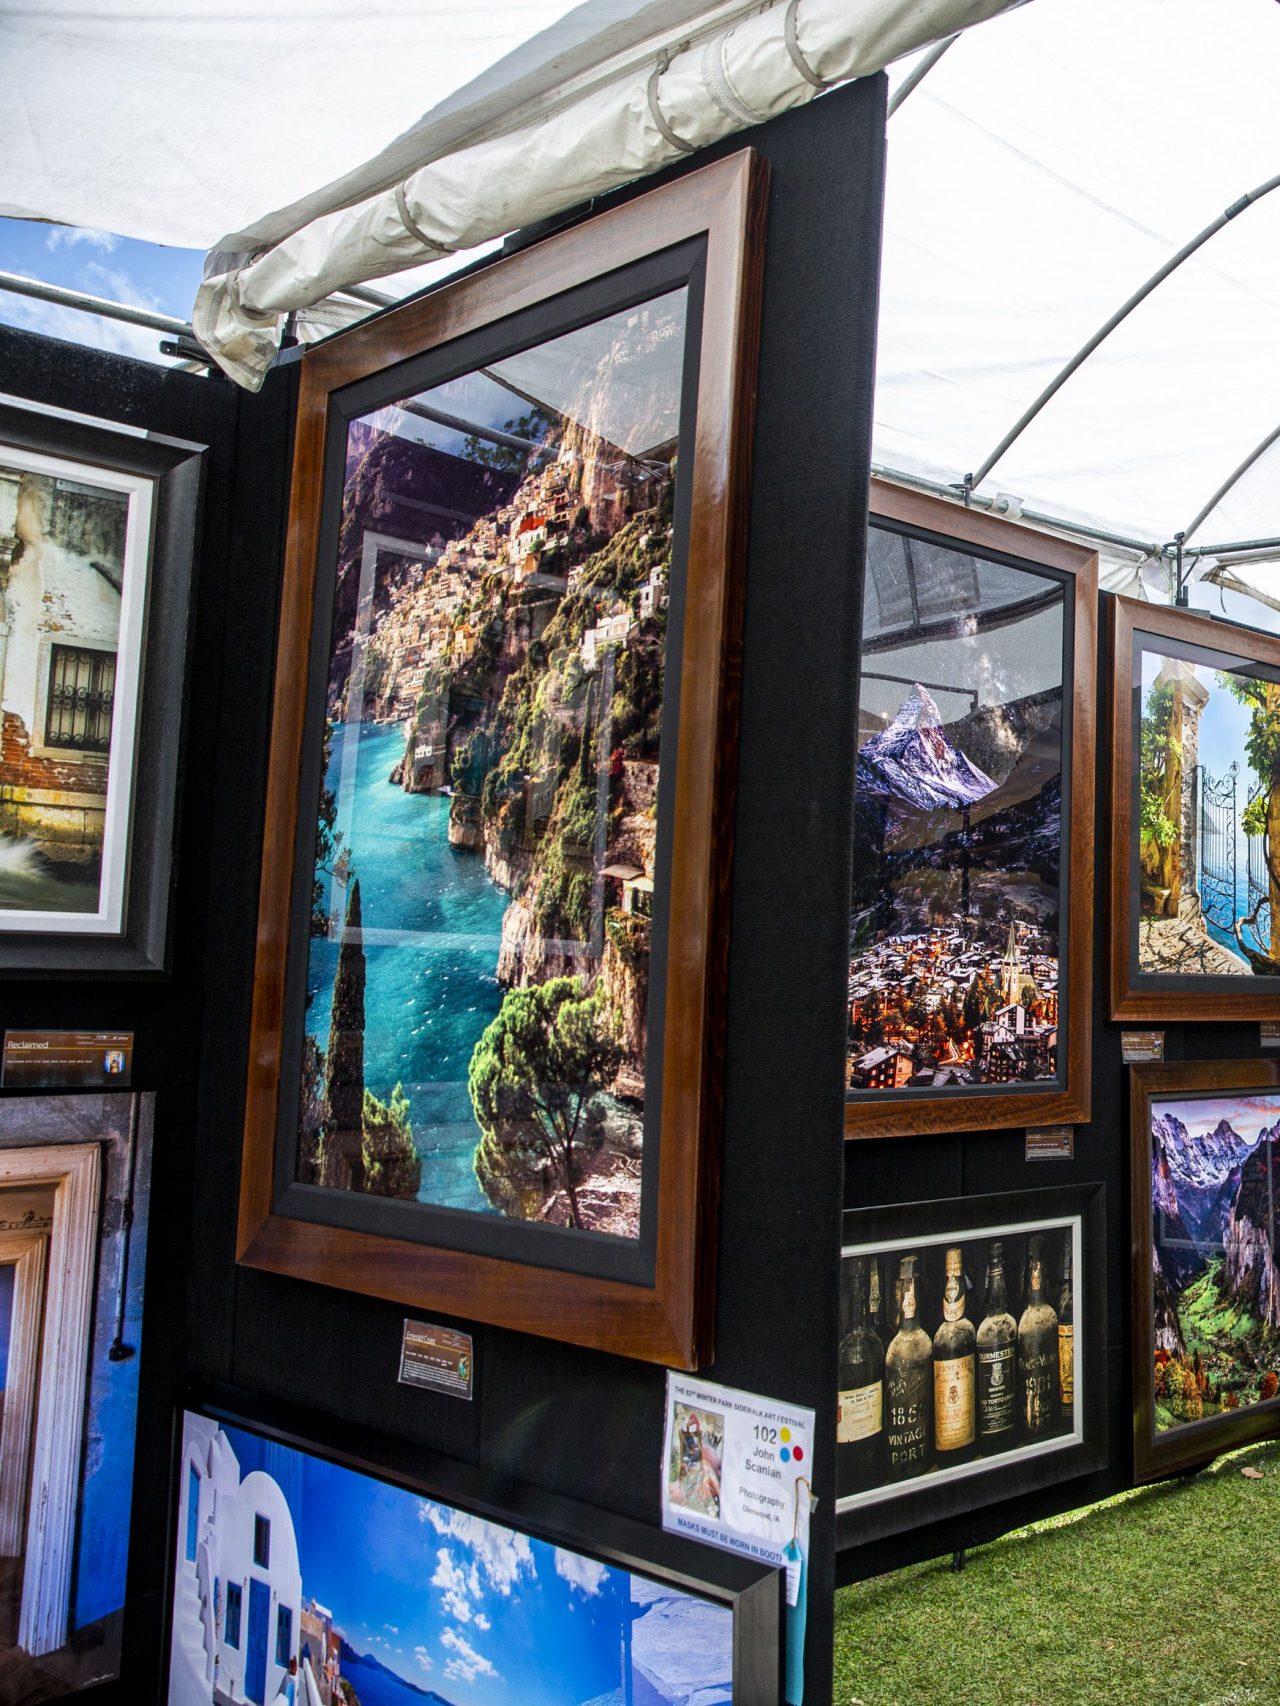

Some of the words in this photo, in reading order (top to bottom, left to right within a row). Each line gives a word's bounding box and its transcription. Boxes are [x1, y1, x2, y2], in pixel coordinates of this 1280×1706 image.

[7, 1041, 49, 1049] Reclaimed
[675, 1385, 685, 1395] THE
[696, 1392, 717, 1403] WINTER
[717, 1398, 733, 1408] PARK
[734, 1403, 764, 1418] SIDEWALK
[764, 1412, 776, 1421] ART
[776, 1415, 806, 1429] FESTIVAL
[753, 1424, 777, 1445] 102
[753, 1446, 775, 1462] John
[745, 1459, 782, 1479] Scanlan
[739, 1486, 785, 1510] Photography
[677, 1518, 700, 1532] MASKS
[701, 1526, 719, 1539] MUST
[719, 1533, 729, 1543] BE
[729, 1537, 750, 1552] WORN
[751, 1545, 759, 1554] IN
